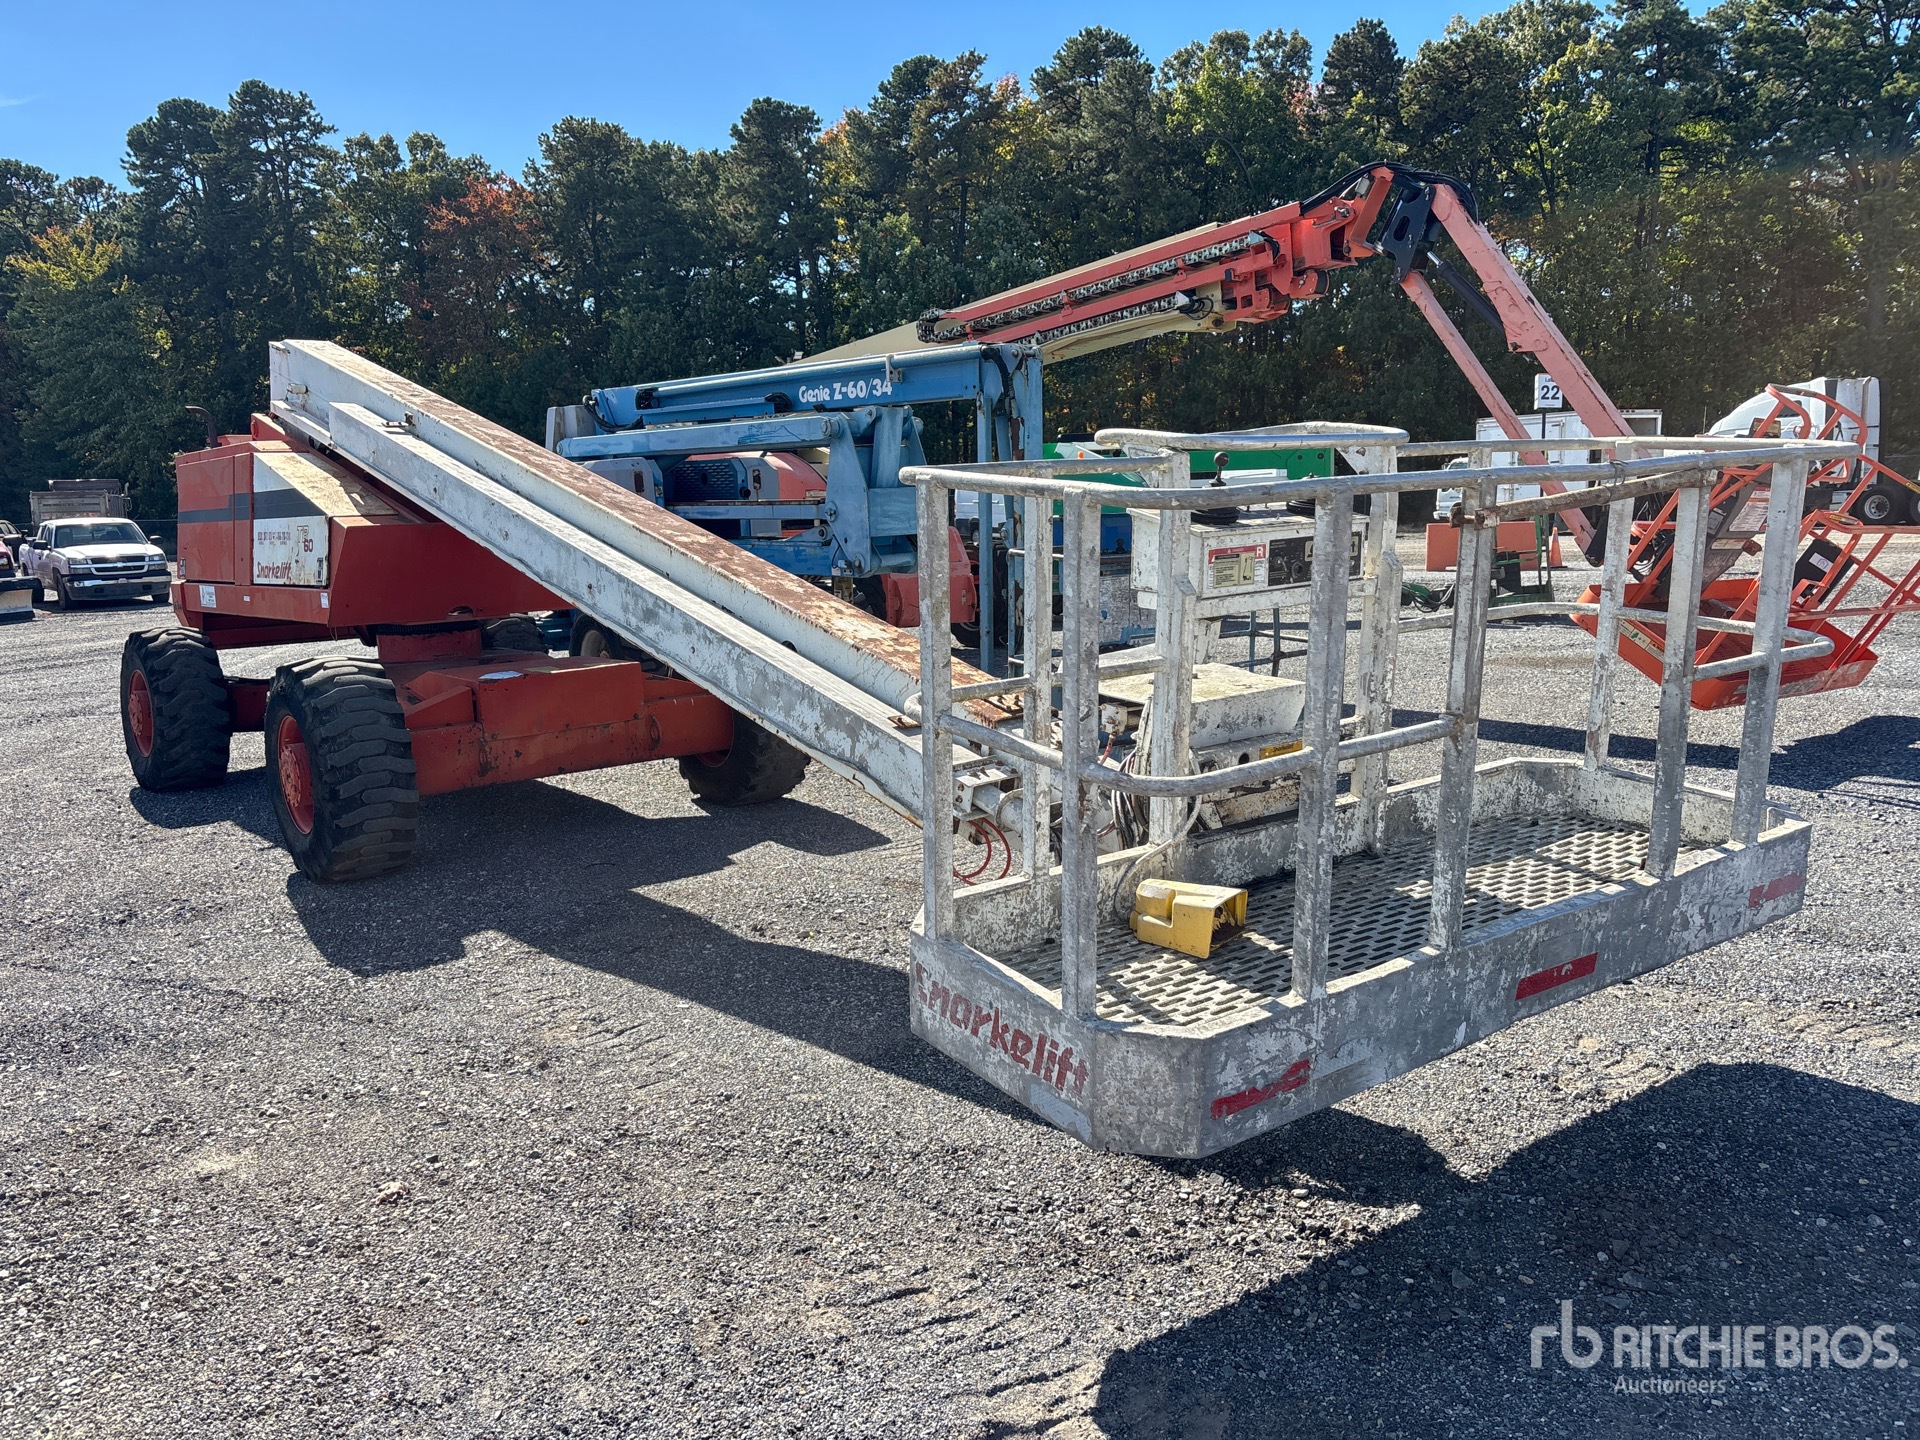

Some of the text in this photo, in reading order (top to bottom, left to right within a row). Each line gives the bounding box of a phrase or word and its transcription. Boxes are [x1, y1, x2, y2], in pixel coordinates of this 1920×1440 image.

[799, 378, 893, 403] Genie Z-60/34
[1541, 385, 1560, 400] 22
[304, 538, 313, 552] 60
[257, 561, 291, 579] Snorkelift
